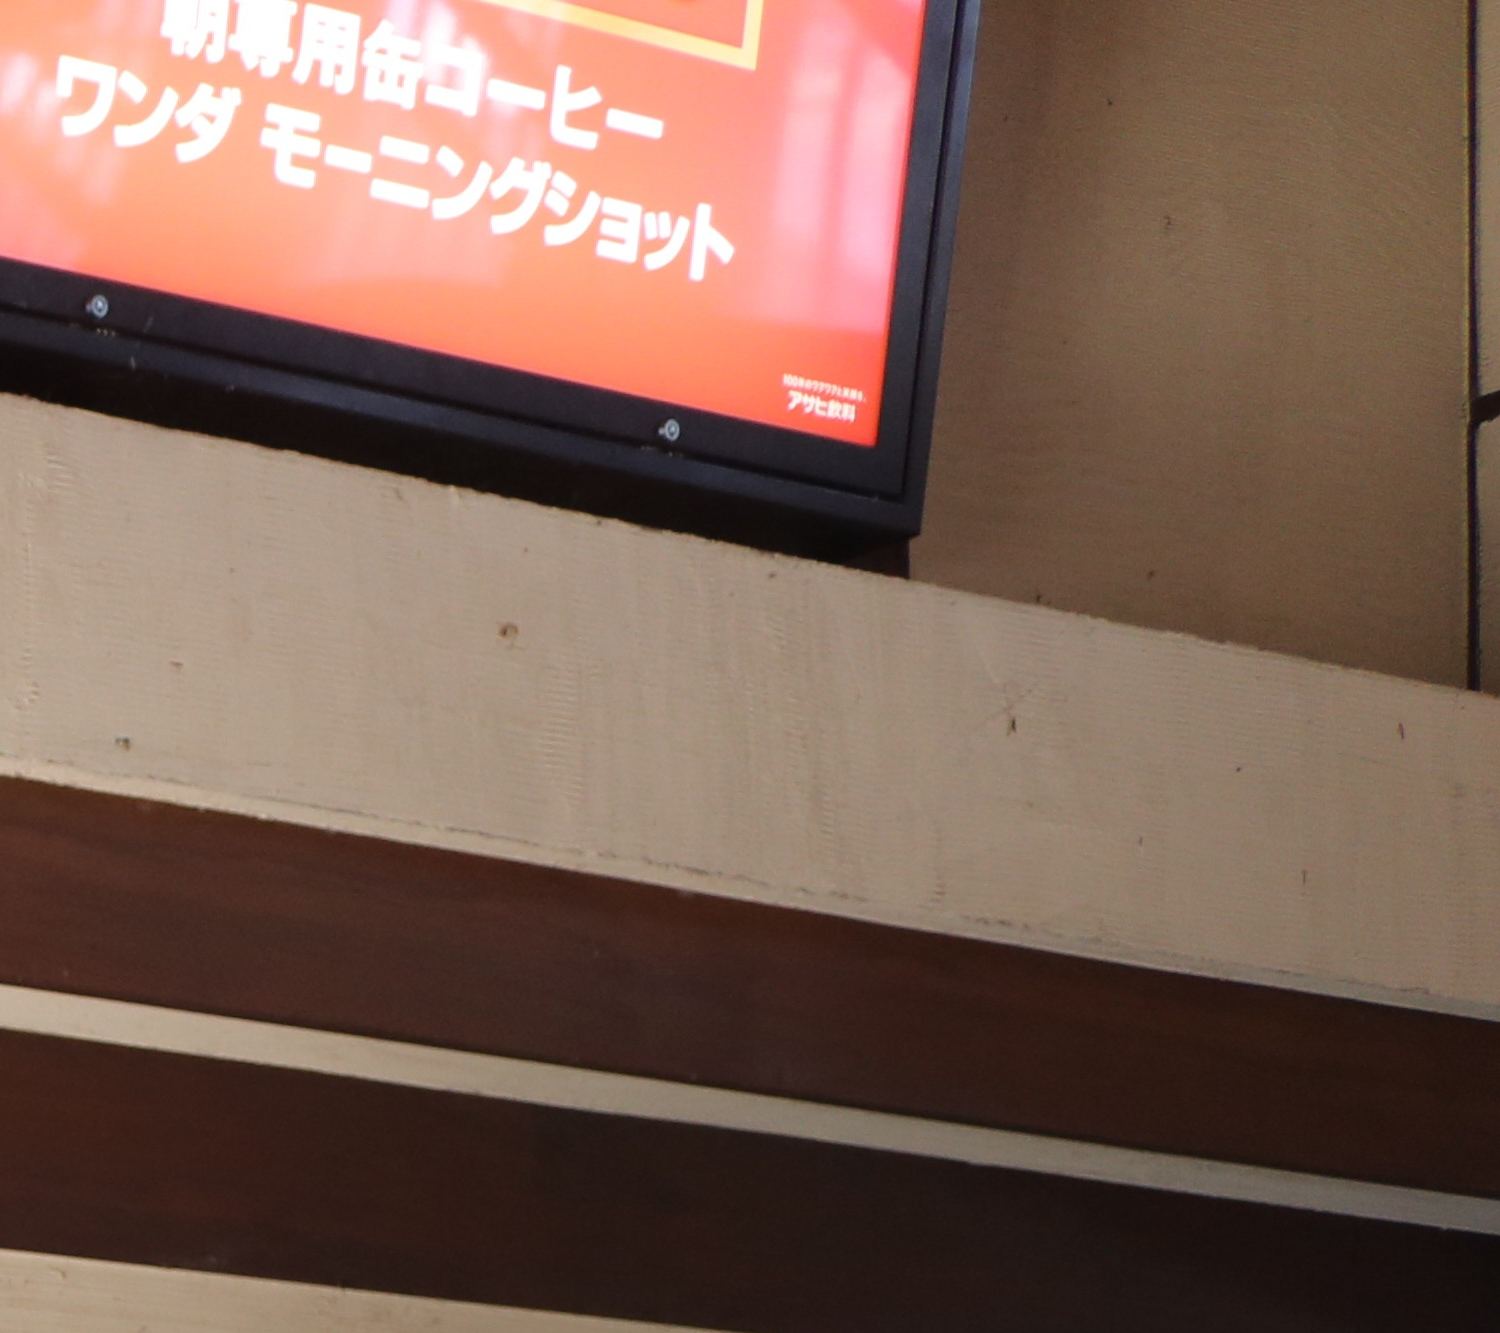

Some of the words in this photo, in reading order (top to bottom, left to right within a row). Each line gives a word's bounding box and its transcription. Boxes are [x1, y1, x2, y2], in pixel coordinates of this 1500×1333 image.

[57, 55, 242, 163] ワンダ
[260, 103, 735, 281] モーニングショット
